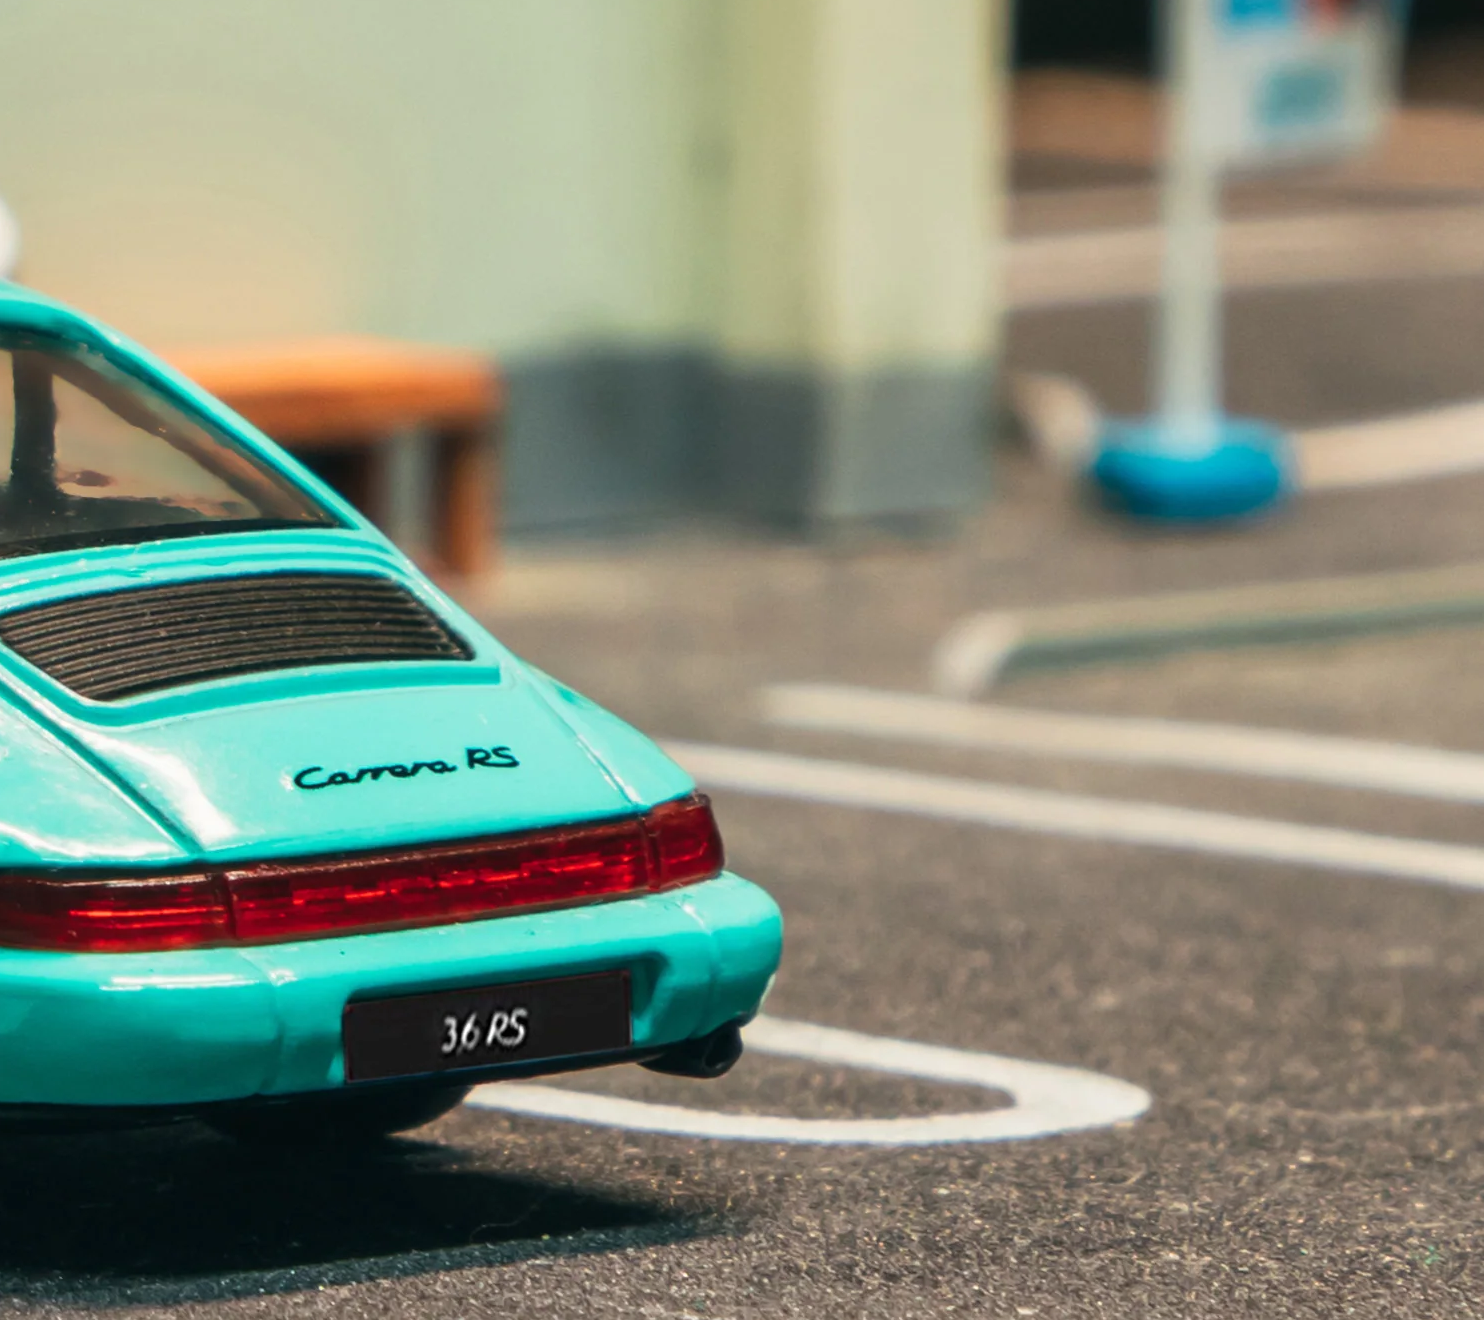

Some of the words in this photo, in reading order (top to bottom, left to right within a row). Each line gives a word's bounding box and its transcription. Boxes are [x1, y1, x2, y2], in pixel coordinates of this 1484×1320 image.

[293, 758, 457, 790] Carrera
[465, 746, 520, 769] RS
[486, 1007, 528, 1047] RS
